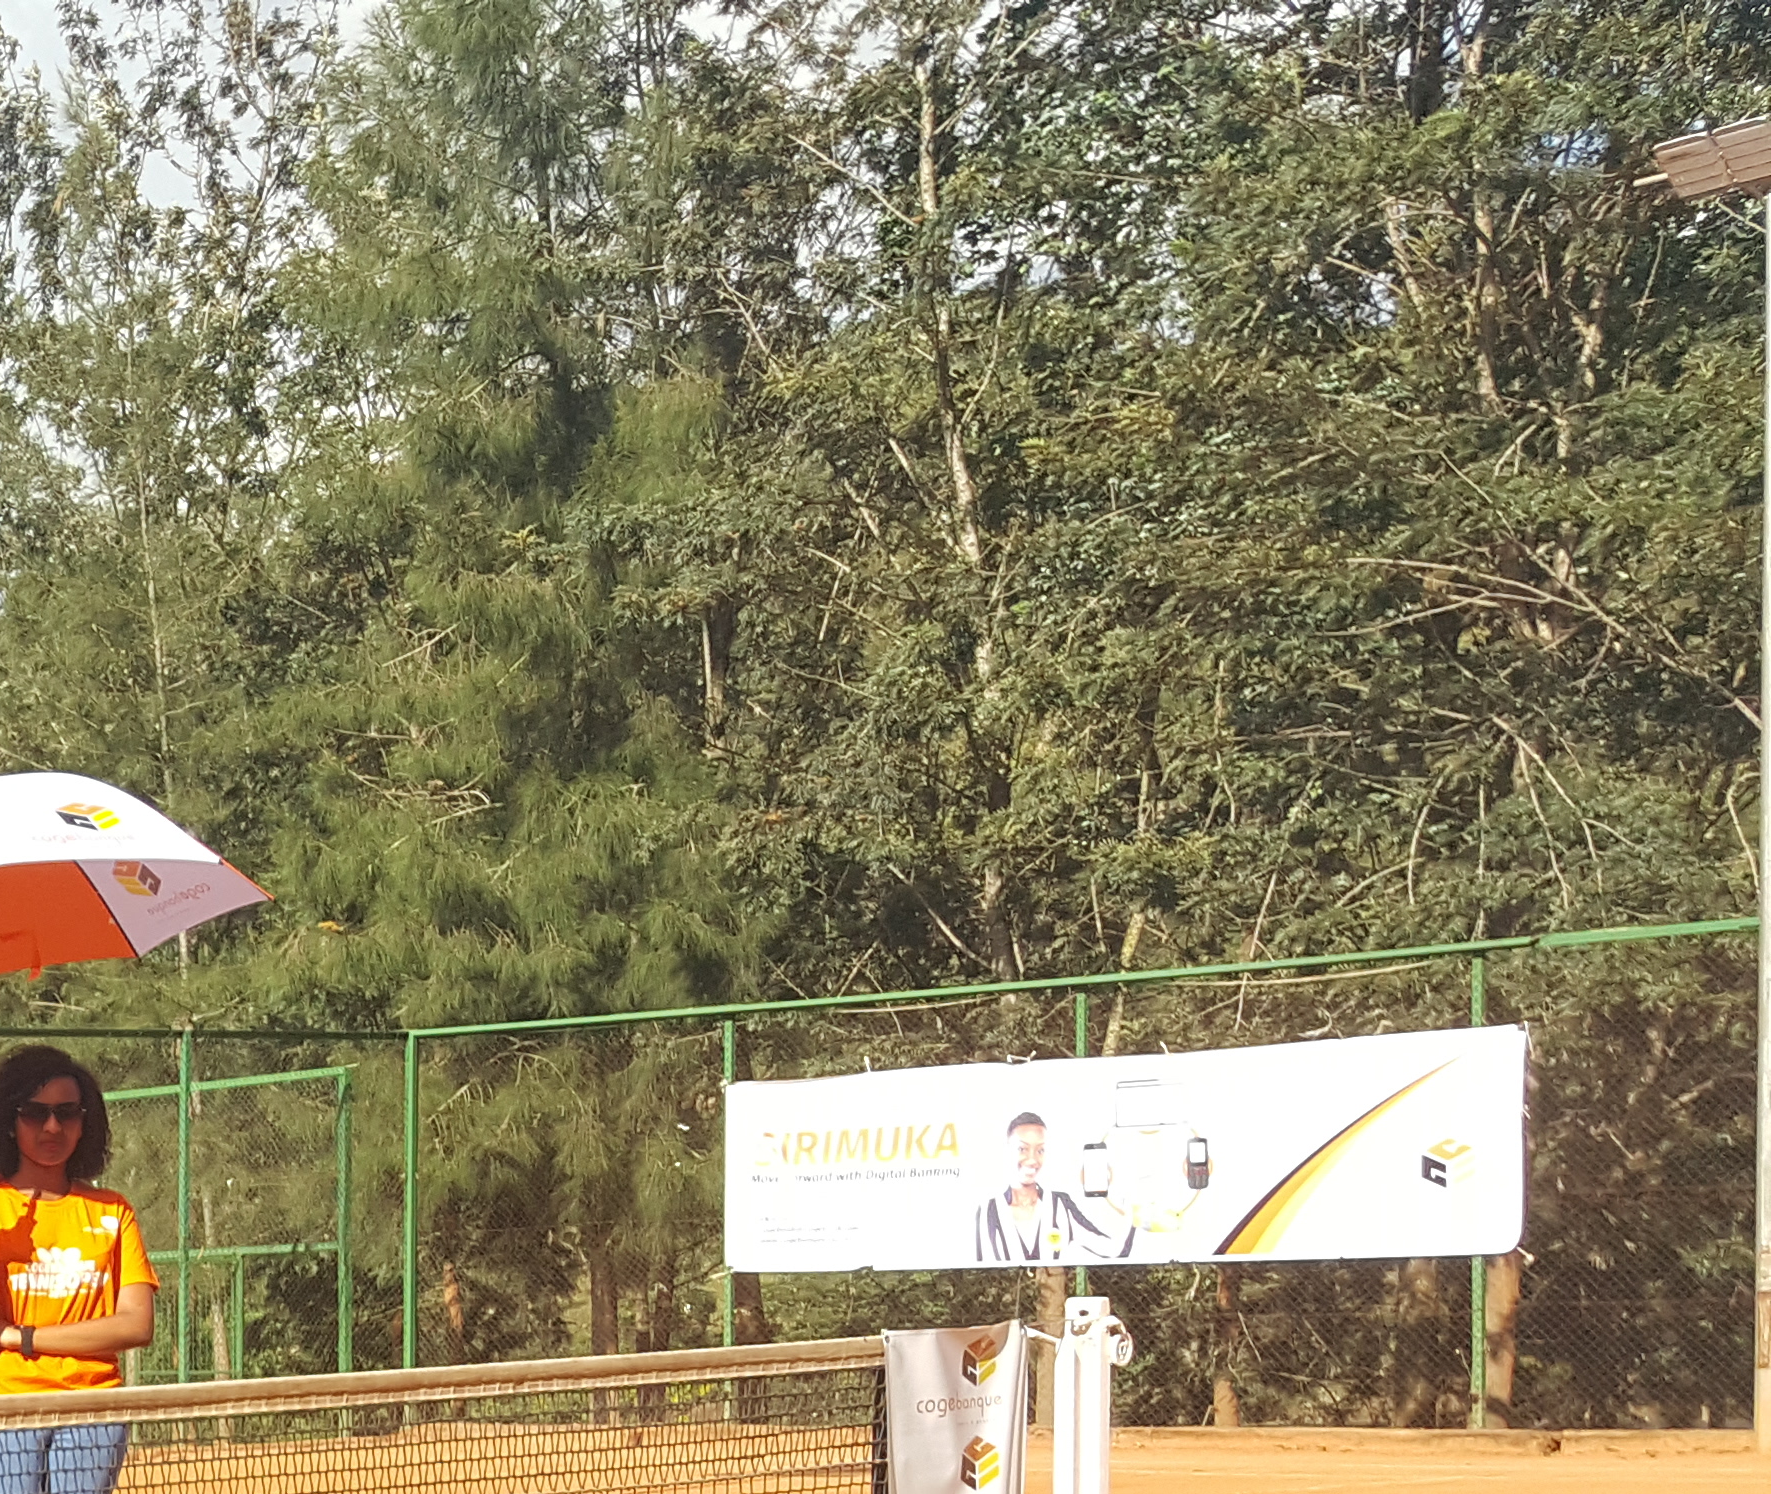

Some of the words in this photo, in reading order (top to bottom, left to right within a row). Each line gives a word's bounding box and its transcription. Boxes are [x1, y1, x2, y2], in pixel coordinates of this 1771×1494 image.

[752, 1174, 779, 1184] Mov
[836, 1171, 862, 1182] with
[866, 1169, 906, 1182] Digital
[916, 1390, 1003, 1418] cogebanque
